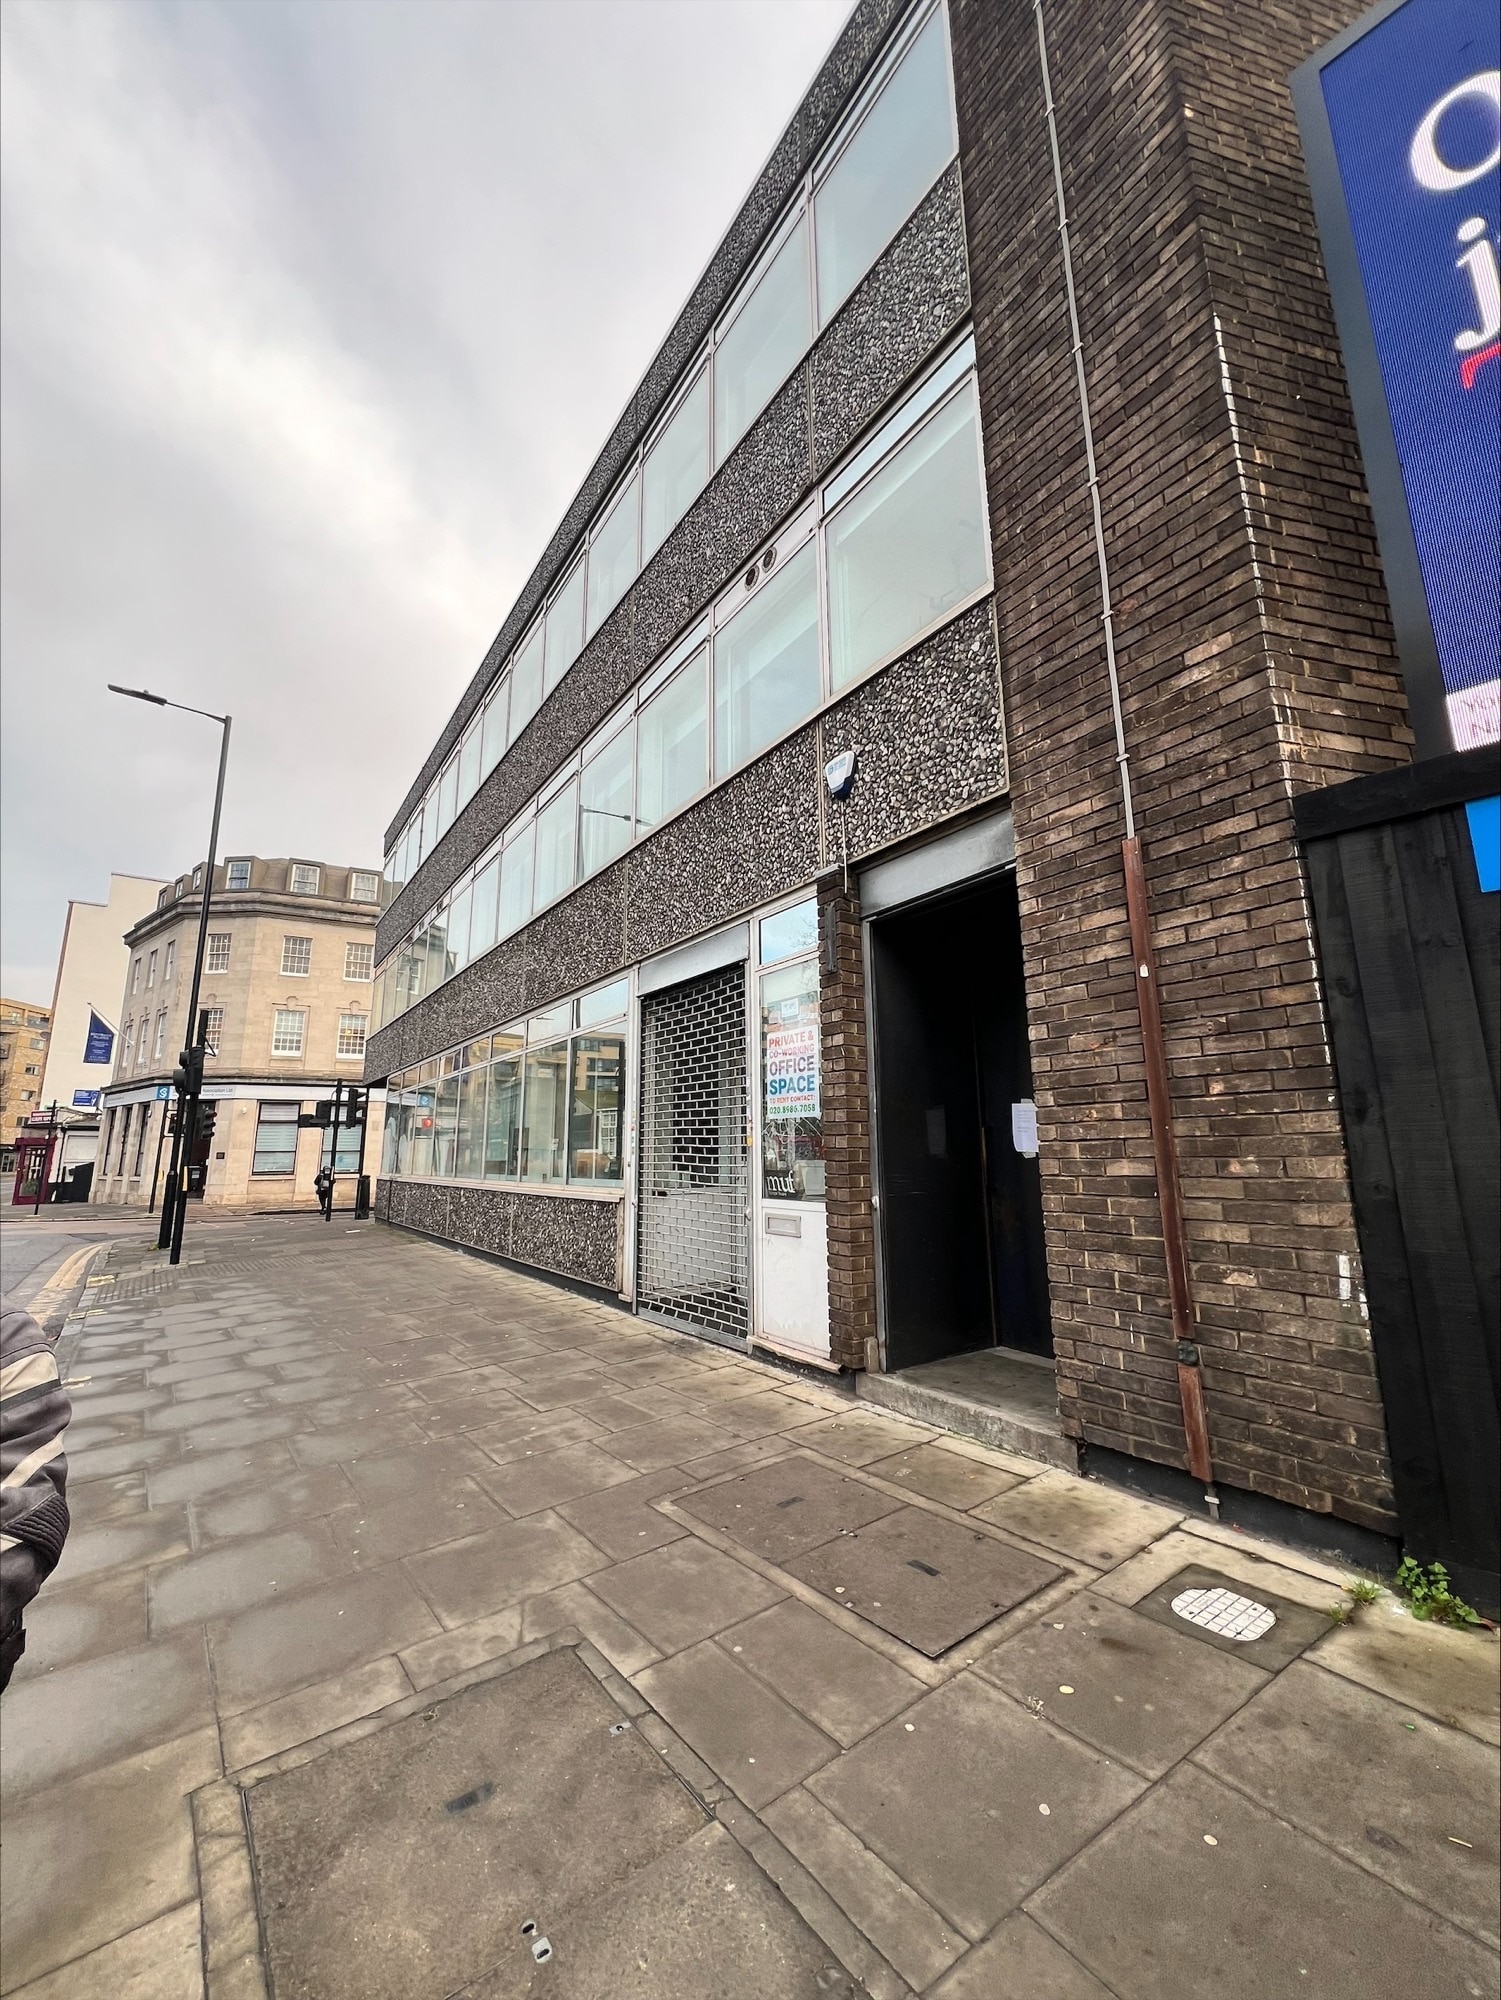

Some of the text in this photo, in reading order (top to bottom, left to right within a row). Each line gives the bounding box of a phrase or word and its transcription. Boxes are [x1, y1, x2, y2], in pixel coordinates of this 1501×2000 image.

[769, 1030, 814, 1048] PRIVATE &
[769, 1043, 814, 1059] CO-WORKING
[769, 1054, 815, 1076] OFFICE
[769, 1074, 815, 1095] SPACE
[777, 1096, 789, 1104] RENT
[767, 1170, 796, 1193] muf
